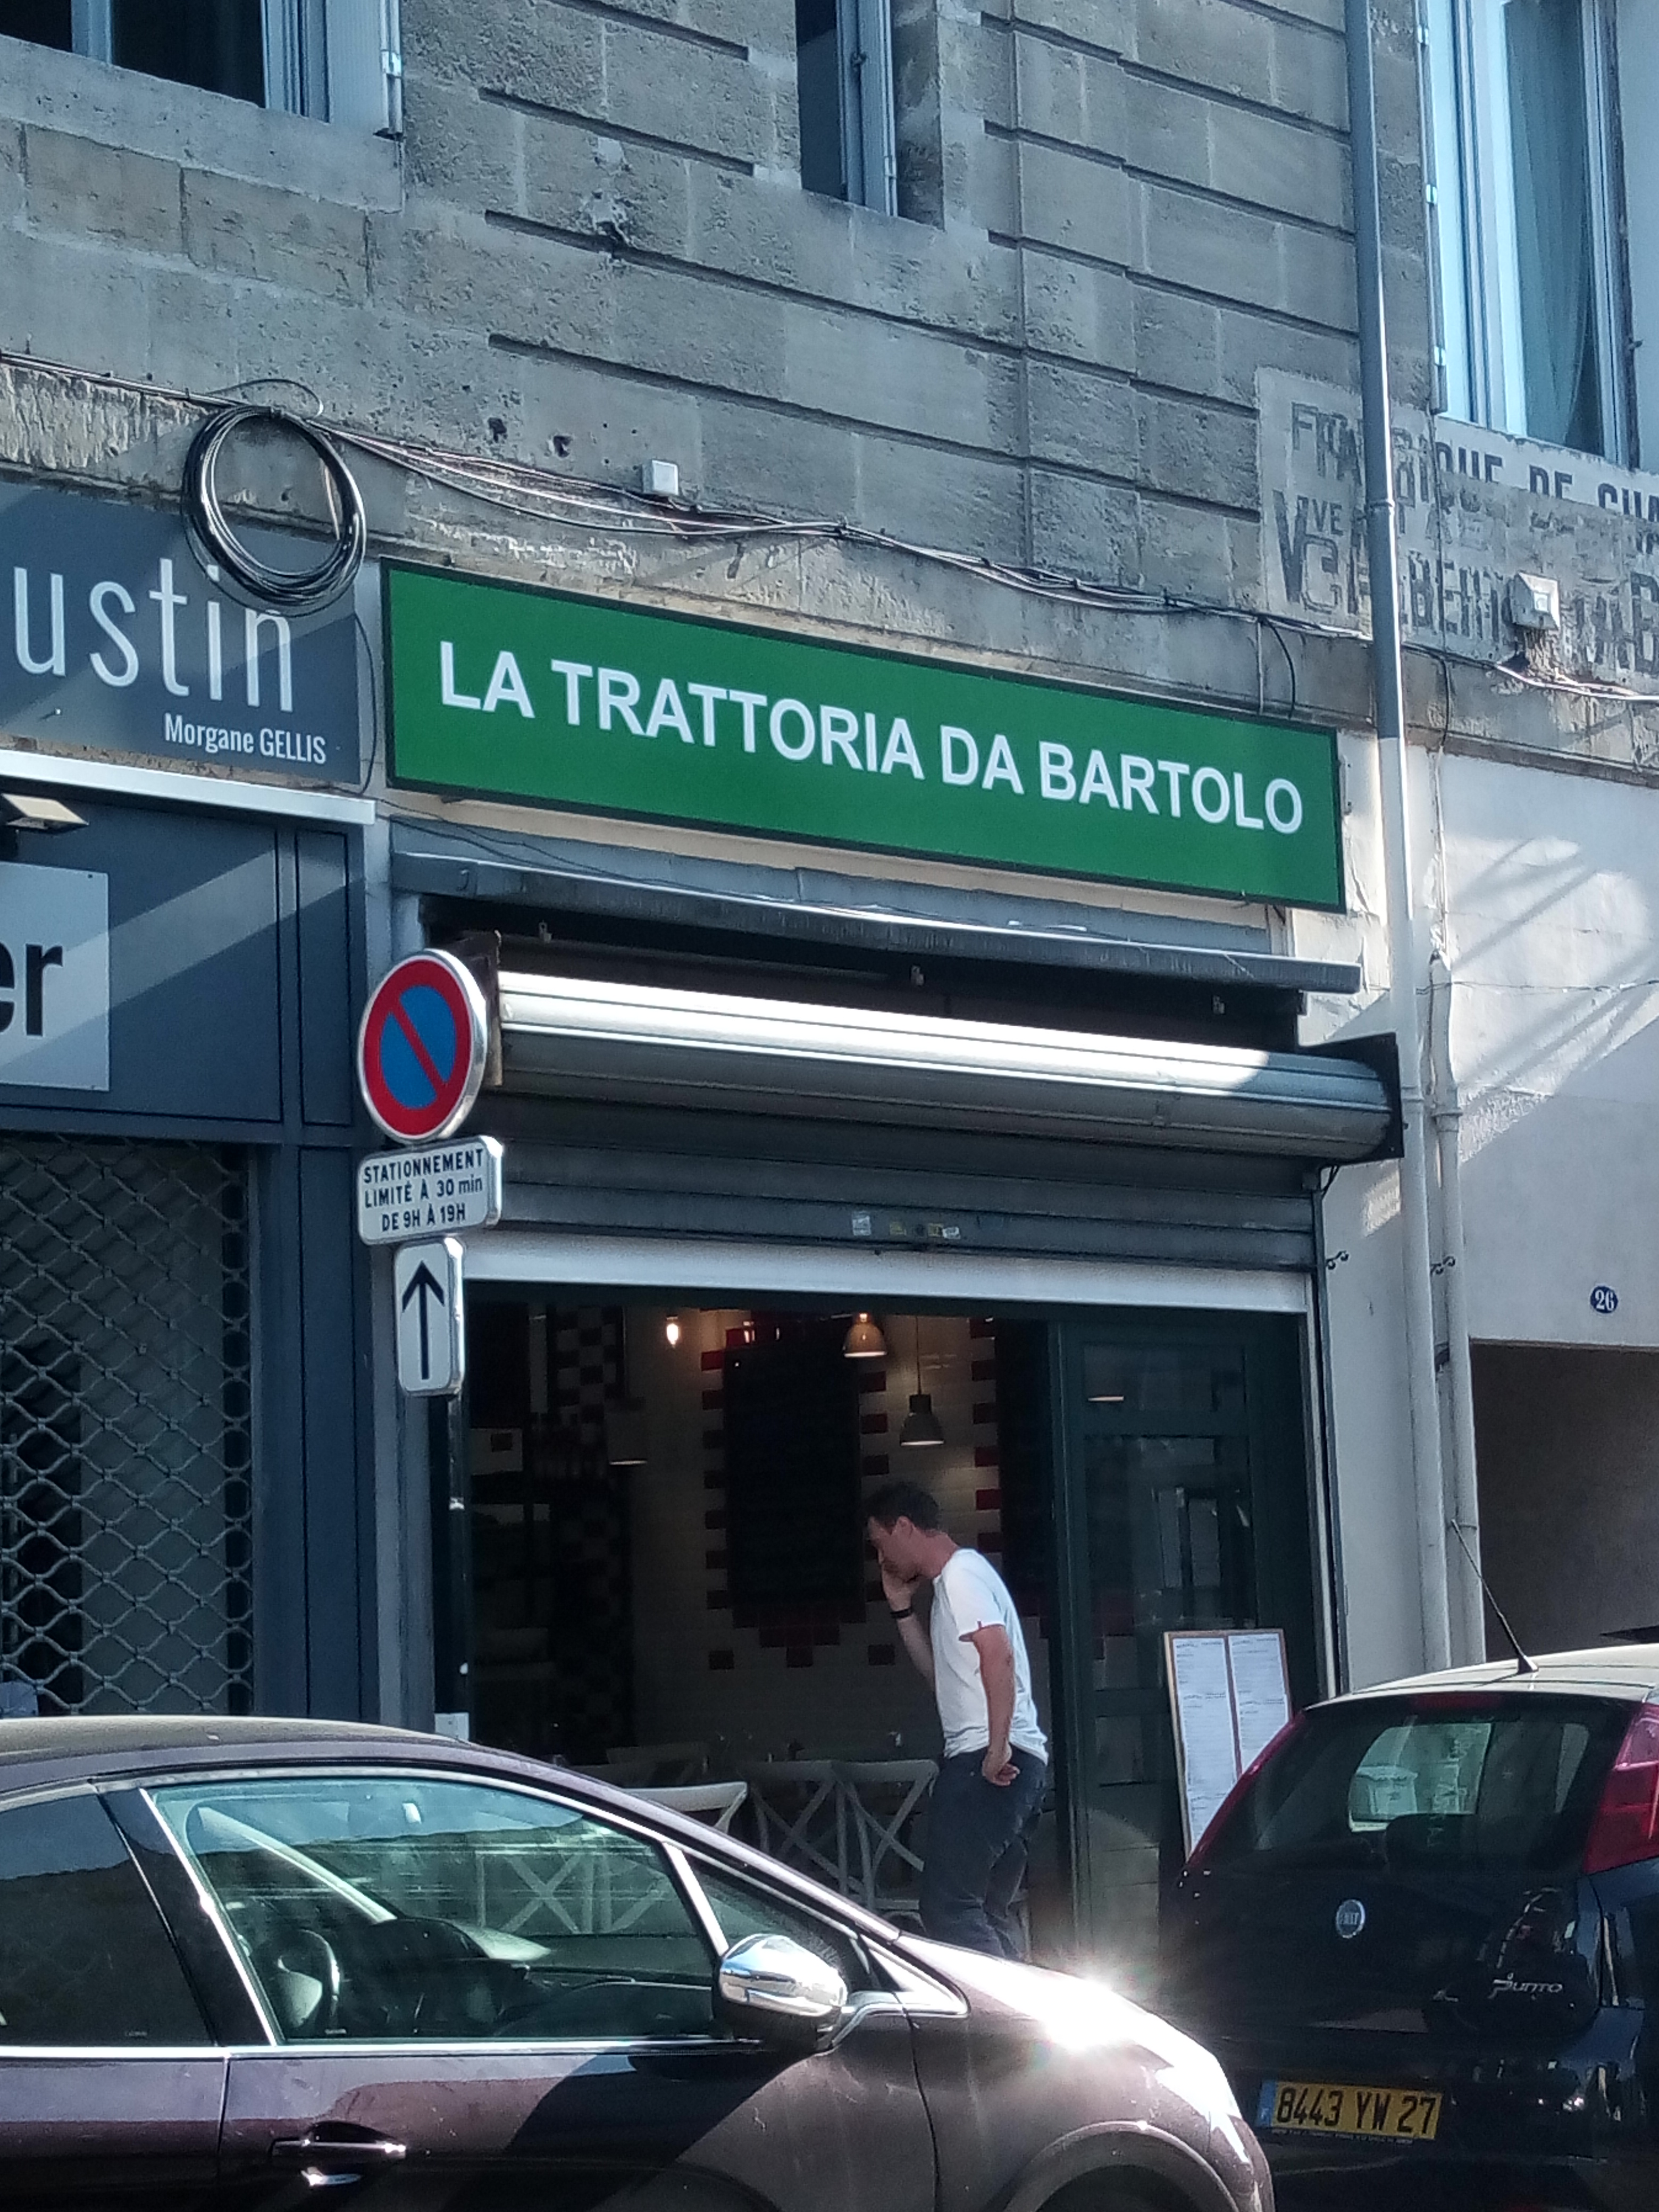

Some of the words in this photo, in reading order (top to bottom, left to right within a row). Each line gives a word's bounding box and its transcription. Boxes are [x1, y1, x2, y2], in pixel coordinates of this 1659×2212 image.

[14, 558, 293, 712] ustin
[165, 713, 254, 753] Morgane
[259, 728, 326, 764] GELLIS
[440, 641, 535, 718] LA
[551, 659, 925, 780] TRATTORIA
[940, 725, 1024, 795] DA
[1039, 741, 1303, 834] BARTOLO
[364, 1149, 483, 1184] STATIONNEMENT
[365, 1180, 412, 1209] LIMITÉ
[437, 1178, 455, 1197] 30
[458, 1174, 483, 1195] min
[382, 1212, 399, 1232] DE
[403, 1209, 420, 1229] 9H
[427, 1203, 435, 1226] À
[440, 1203, 465, 1224] 19H
[1595, 1289, 1614, 1311] 26
[1277, 2087, 1344, 2127] 8443
[1356, 2091, 1392, 2131] YW
[1397, 2095, 1436, 2134] 27
